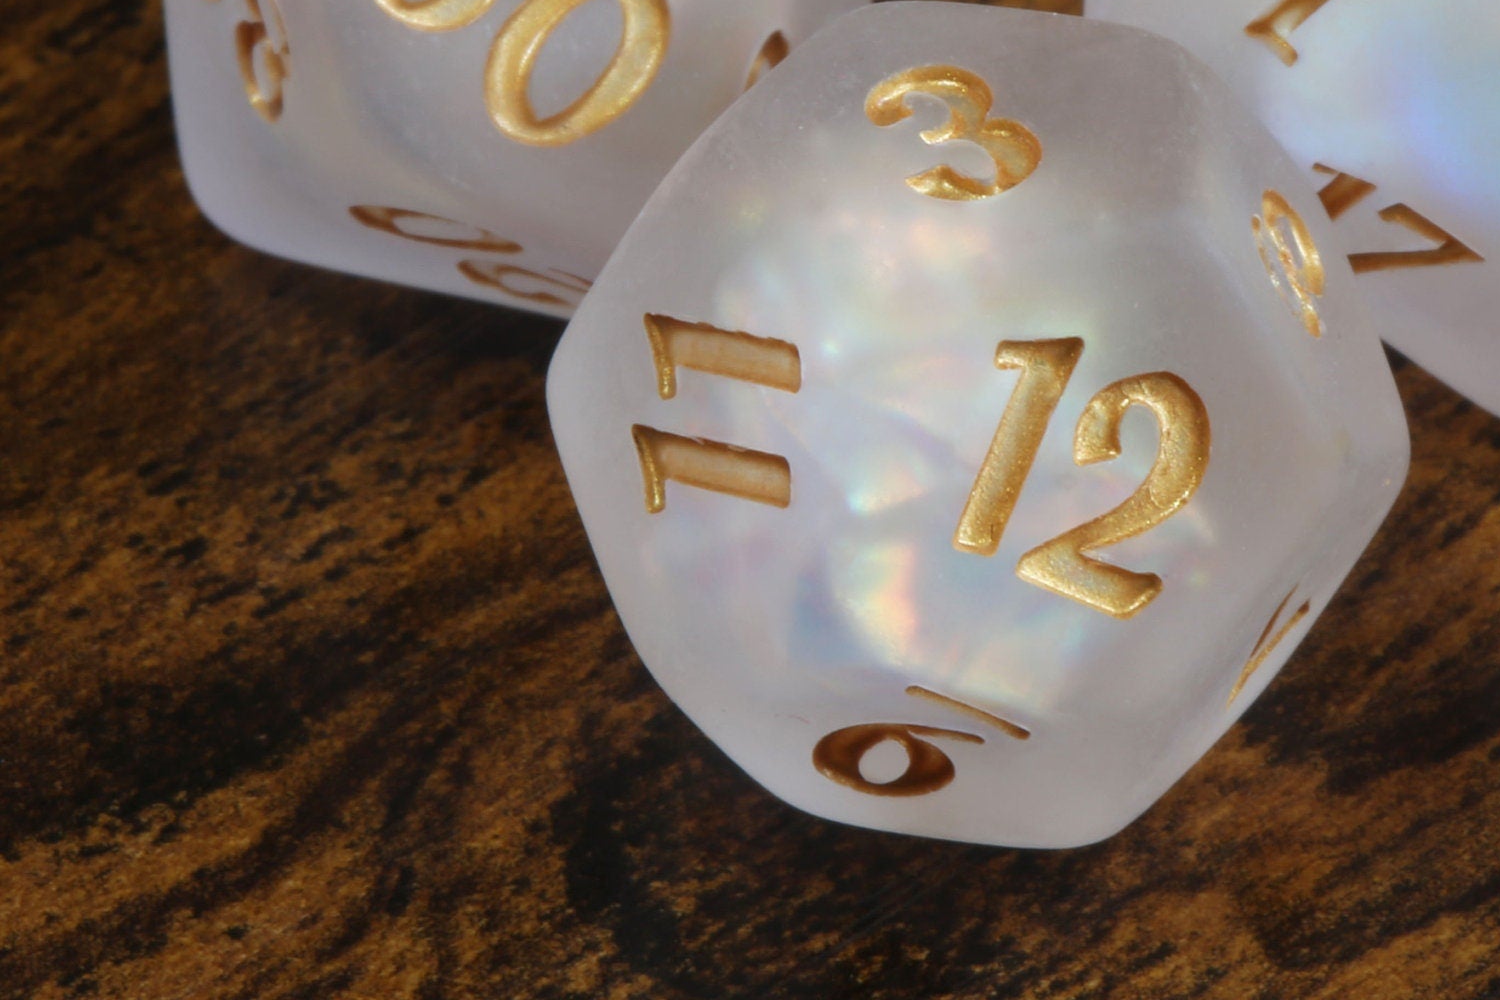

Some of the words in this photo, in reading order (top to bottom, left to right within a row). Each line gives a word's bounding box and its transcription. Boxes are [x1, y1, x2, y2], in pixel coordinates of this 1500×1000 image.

[864, 63, 1044, 203] 3
[629, 311, 802, 516] 11
[950, 335, 1213, 622] 12
